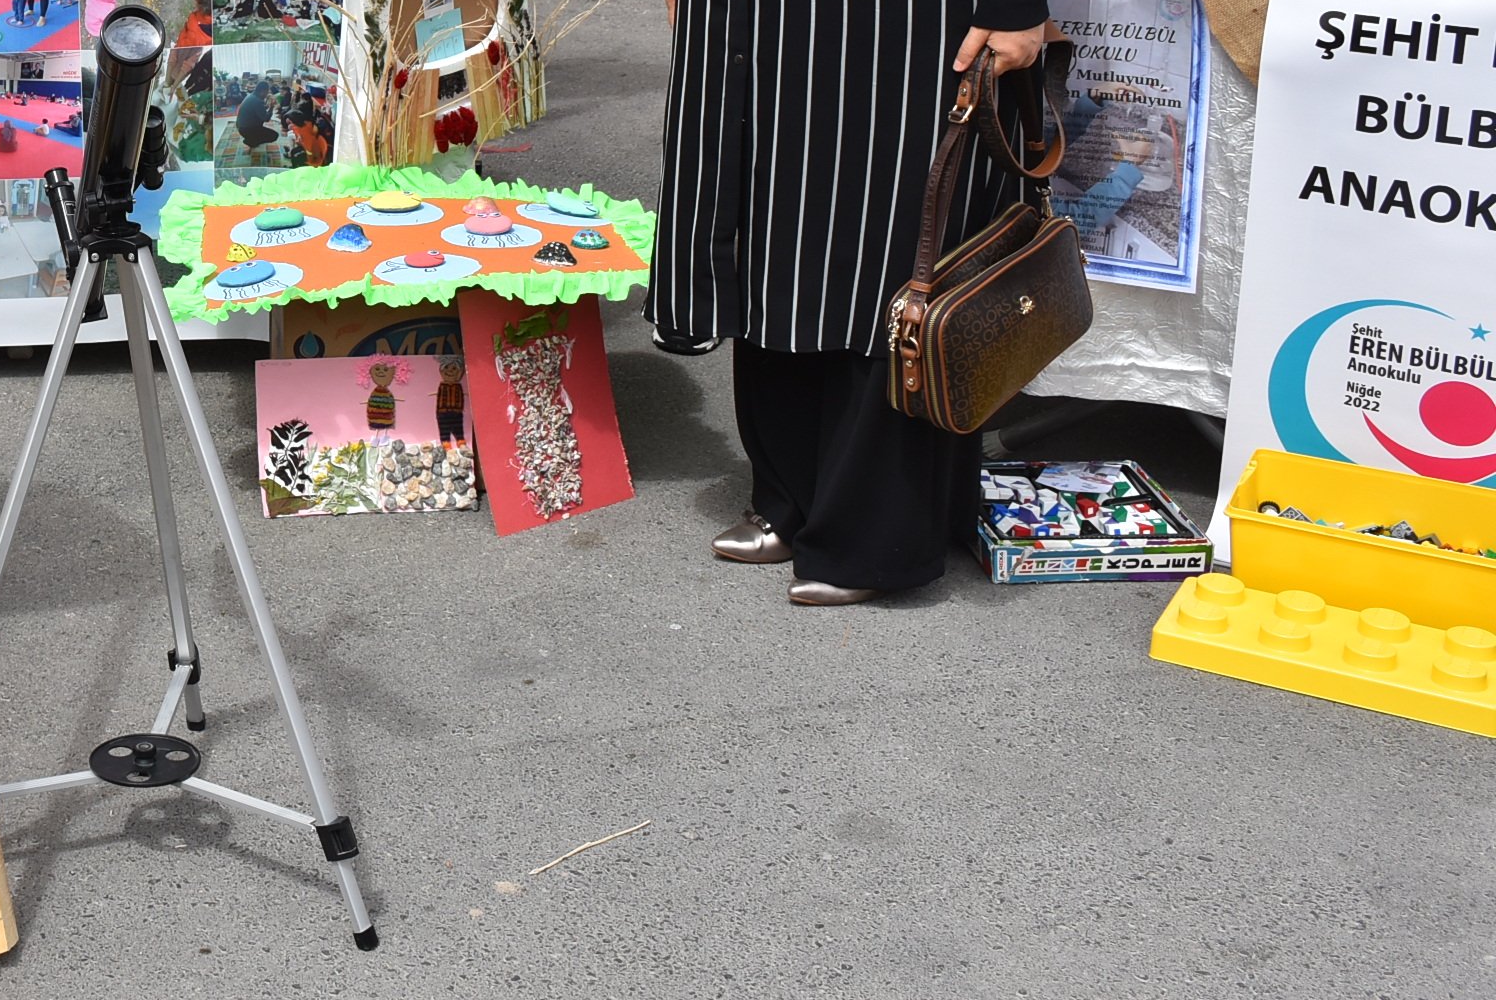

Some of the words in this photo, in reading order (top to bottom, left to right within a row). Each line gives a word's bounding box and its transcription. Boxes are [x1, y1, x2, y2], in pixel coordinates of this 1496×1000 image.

[1060, 21, 1107, 37] EREN
[1110, 22, 1177, 44] BÜLBÜL
[1315, 10, 1479, 64] ŞEHİT
[1073, 44, 1138, 62] OKULU
[1076, 69, 1165, 89] Mutluyum,
[1088, 88, 1182, 109] Umutluyum
[1355, 92, 1496, 148] BÜLB
[1298, 166, 1496, 231] ANAOK
[1352, 323, 1383, 339] Şehit
[1349, 335, 1403, 363] EREN
[1409, 346, 1496, 381] BÜLBÜL
[1347, 357, 1421, 384] Anaokulu
[1346, 381, 1382, 398] Niğde
[1344, 395, 1380, 412] 2022
[1107, 555, 1203, 571] KÜPLER
